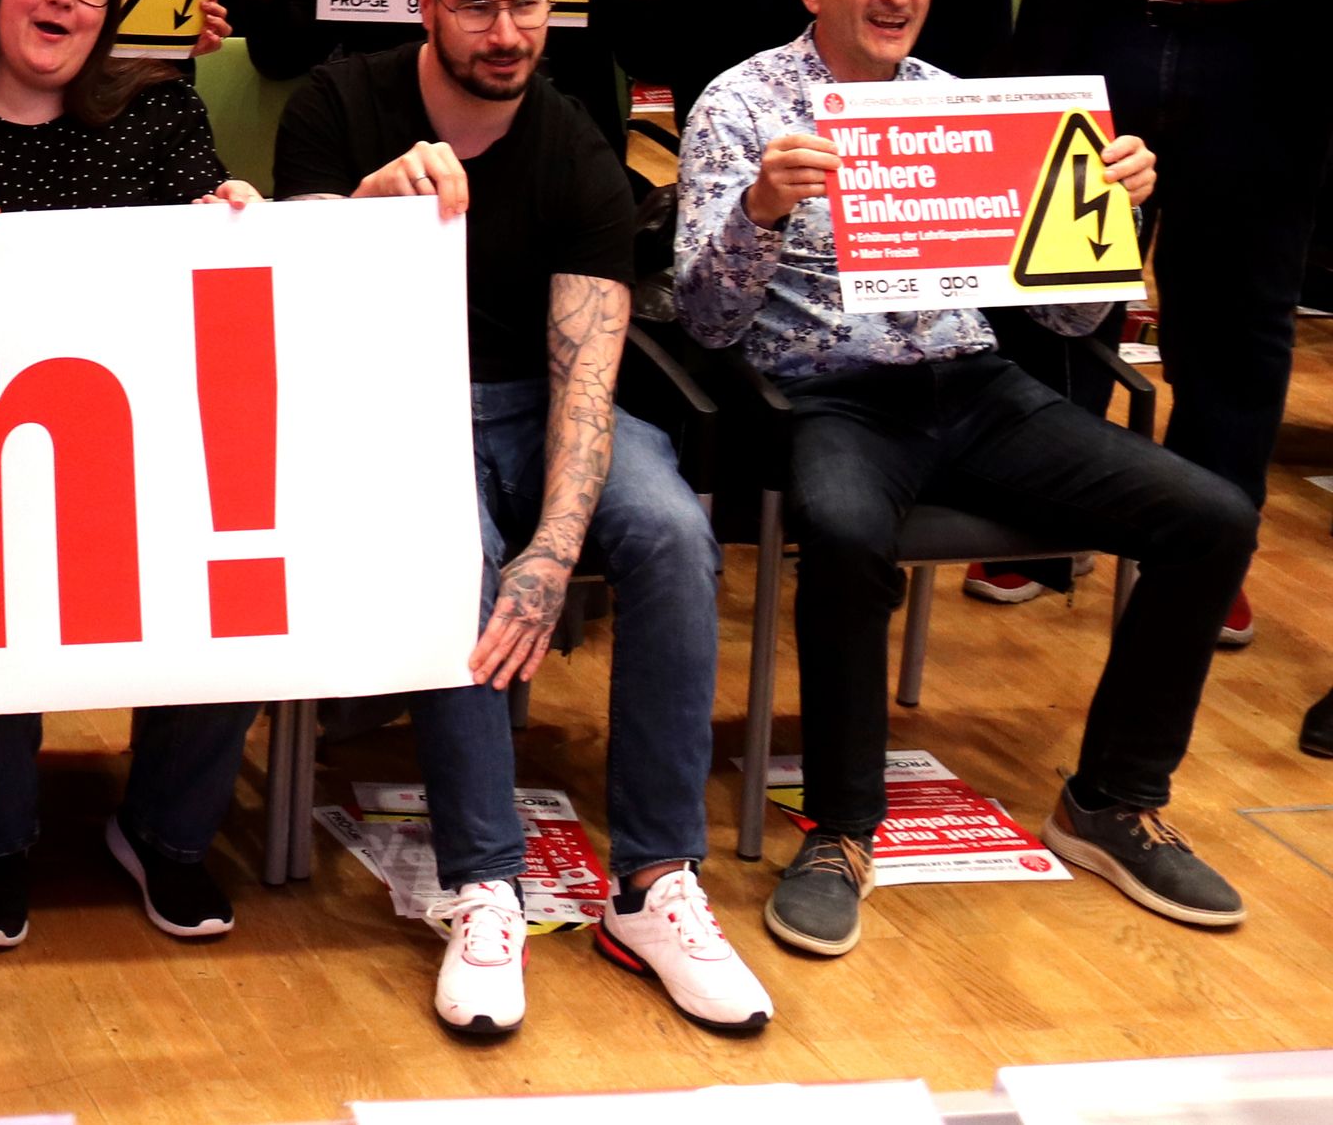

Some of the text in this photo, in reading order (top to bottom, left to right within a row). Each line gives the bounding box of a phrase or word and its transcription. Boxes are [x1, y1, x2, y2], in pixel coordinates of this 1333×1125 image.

[830, 125, 994, 158] Wir fordern
[837, 160, 936, 192] höhere
[841, 188, 1022, 225] Einkommen!
[857, 230, 901, 245] Erhöhung
[903, 231, 917, 242] der
[859, 246, 920, 259] Mehr Freizeit
[854, 274, 979, 298] PRO-GE gpa
